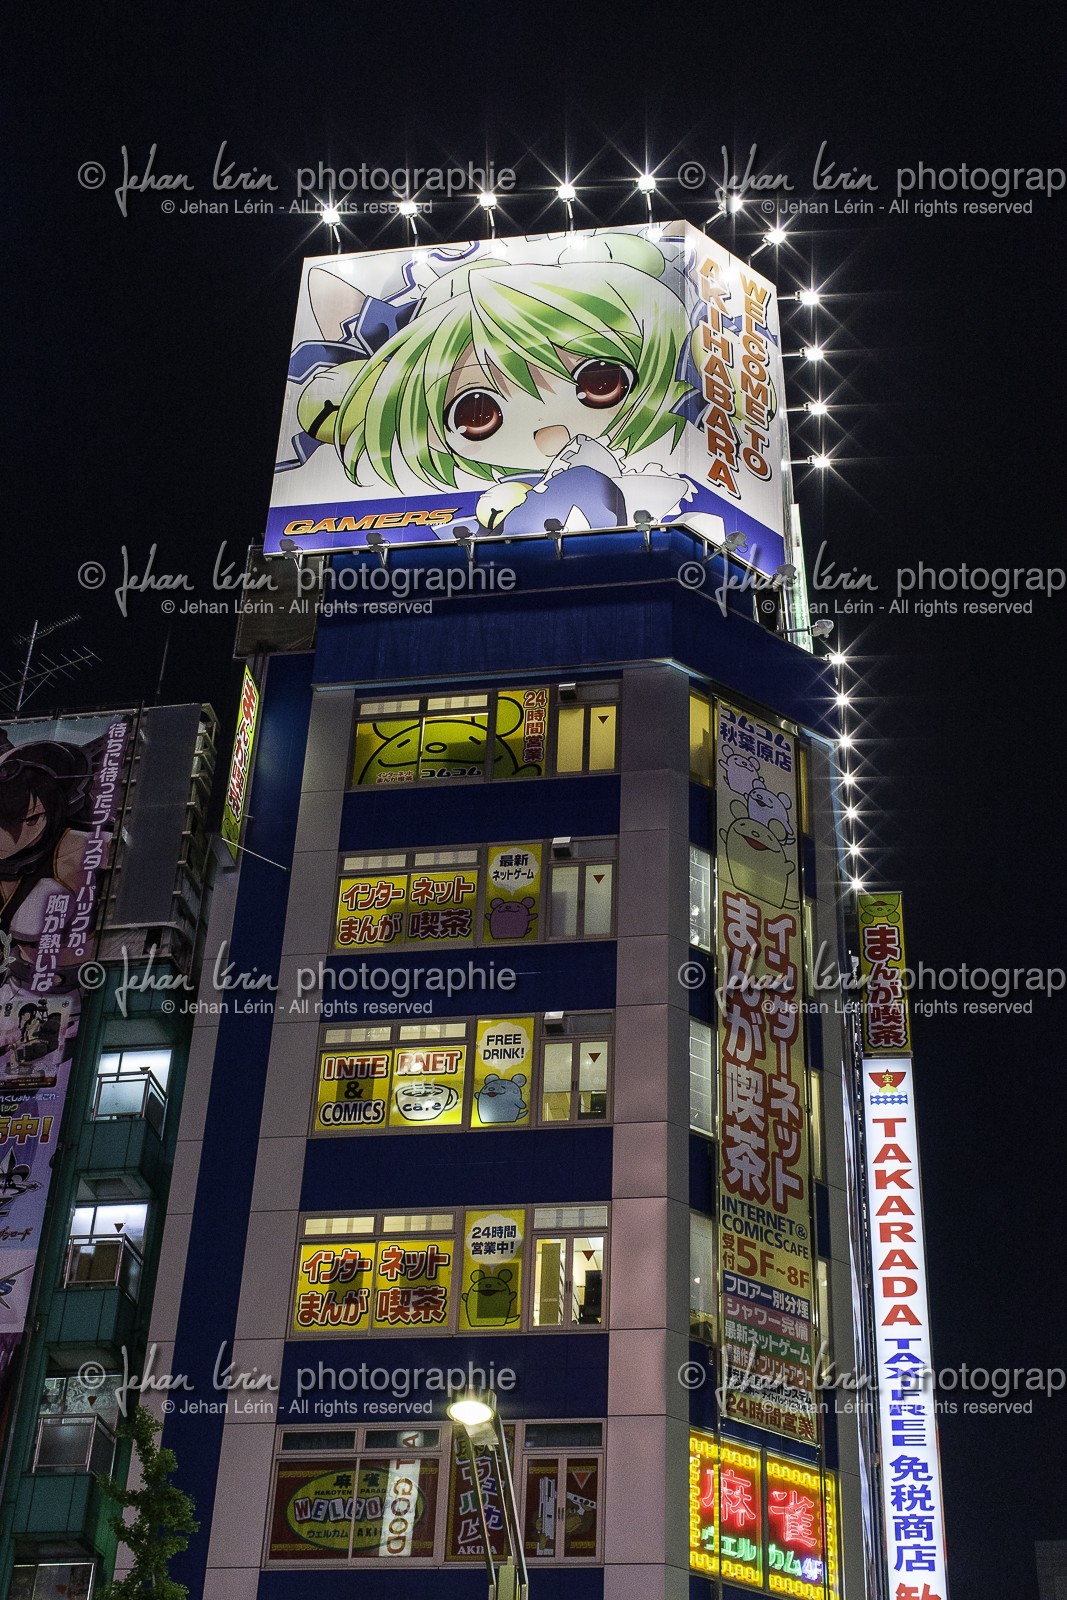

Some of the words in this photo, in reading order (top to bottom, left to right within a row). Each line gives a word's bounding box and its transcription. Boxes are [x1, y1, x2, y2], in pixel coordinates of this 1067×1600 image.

[740, 271, 771, 427] WELCOME
[699, 257, 741, 499] AKIHABARA
[284, 508, 460, 536] GAMERS
[524, 690, 547, 763] 24時間営業
[719, 721, 792, 773] 秋葉原店
[720, 706, 791, 752] コムコム
[420, 766, 482, 779] コムコム
[492, 867, 535, 881] ネットゲーム
[499, 853, 529, 868] 最新
[30, 893, 70, 992] 胸が熱いな
[862, 924, 908, 1049] まんが喫茶
[482, 1047, 525, 1061] DRINK!
[486, 1033, 522, 1046] FREE
[721, 889, 770, 1201] まんが喫茶
[763, 913, 804, 1214] インターネット
[319, 1100, 386, 1126] COMICS
[344, 1081, 364, 1099] &
[471, 1224, 517, 1240] 24時間
[872, 1117, 923, 1327] TAKARADA
[724, 1273, 810, 1321] フロアー別分煙
[726, 1297, 809, 1343] シャワー完備
[724, 1319, 811, 1366] 最新ネットゲーム
[702, 1470, 817, 1548] 麻雀
[889, 1454, 937, 1573] 免税商店
[457, 1544, 498, 1555] AKIA
